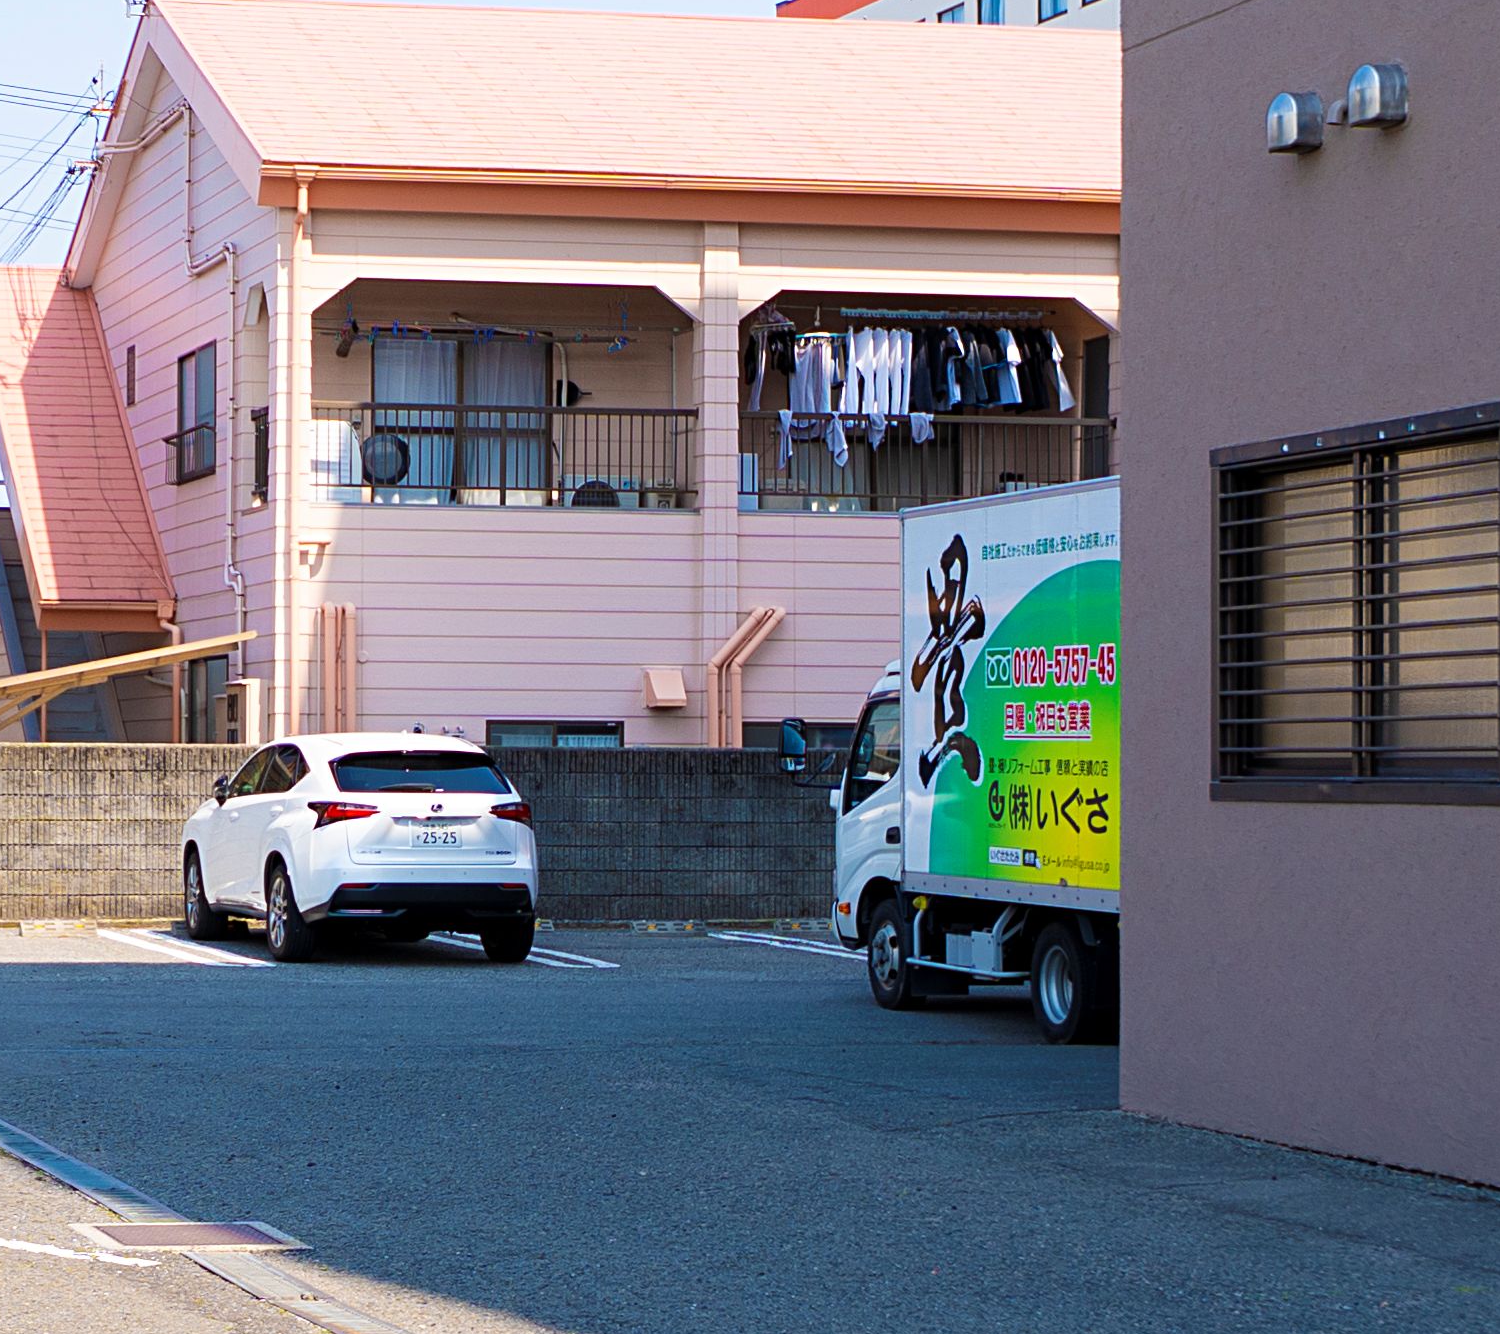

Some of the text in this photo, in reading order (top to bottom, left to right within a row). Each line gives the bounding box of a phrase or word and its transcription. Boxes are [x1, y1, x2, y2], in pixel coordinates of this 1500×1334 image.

[1014, 645, 1115, 686] 0120-5757-45
[1005, 702, 1091, 731] 日曜・祝日も営業
